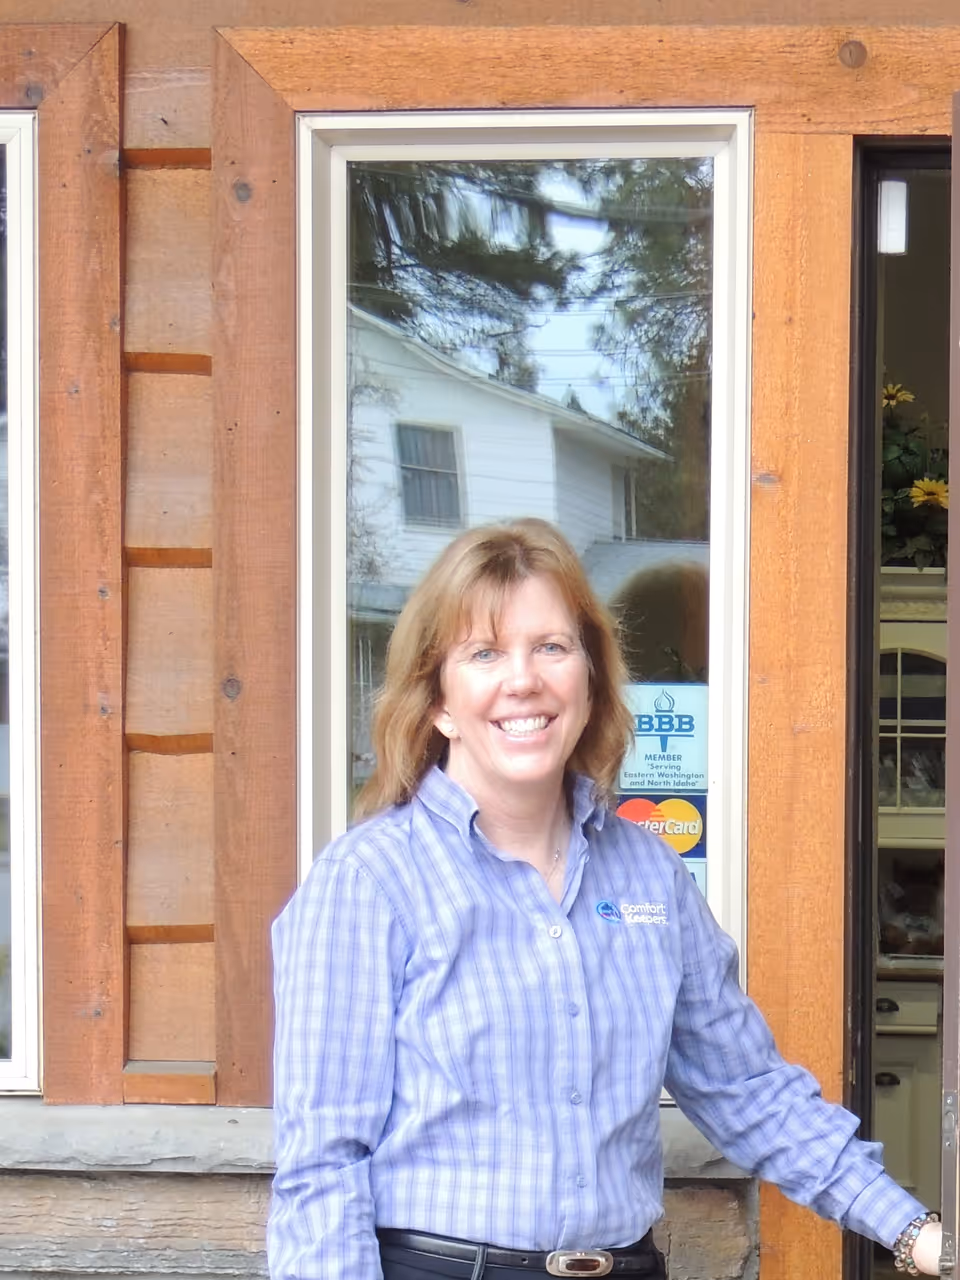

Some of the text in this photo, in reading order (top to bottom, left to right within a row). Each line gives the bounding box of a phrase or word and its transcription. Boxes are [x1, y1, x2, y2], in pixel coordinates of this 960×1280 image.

[634, 714, 695, 732] BBB
[657, 772, 705, 780] Washington
[621, 903, 666, 914] Comfort
